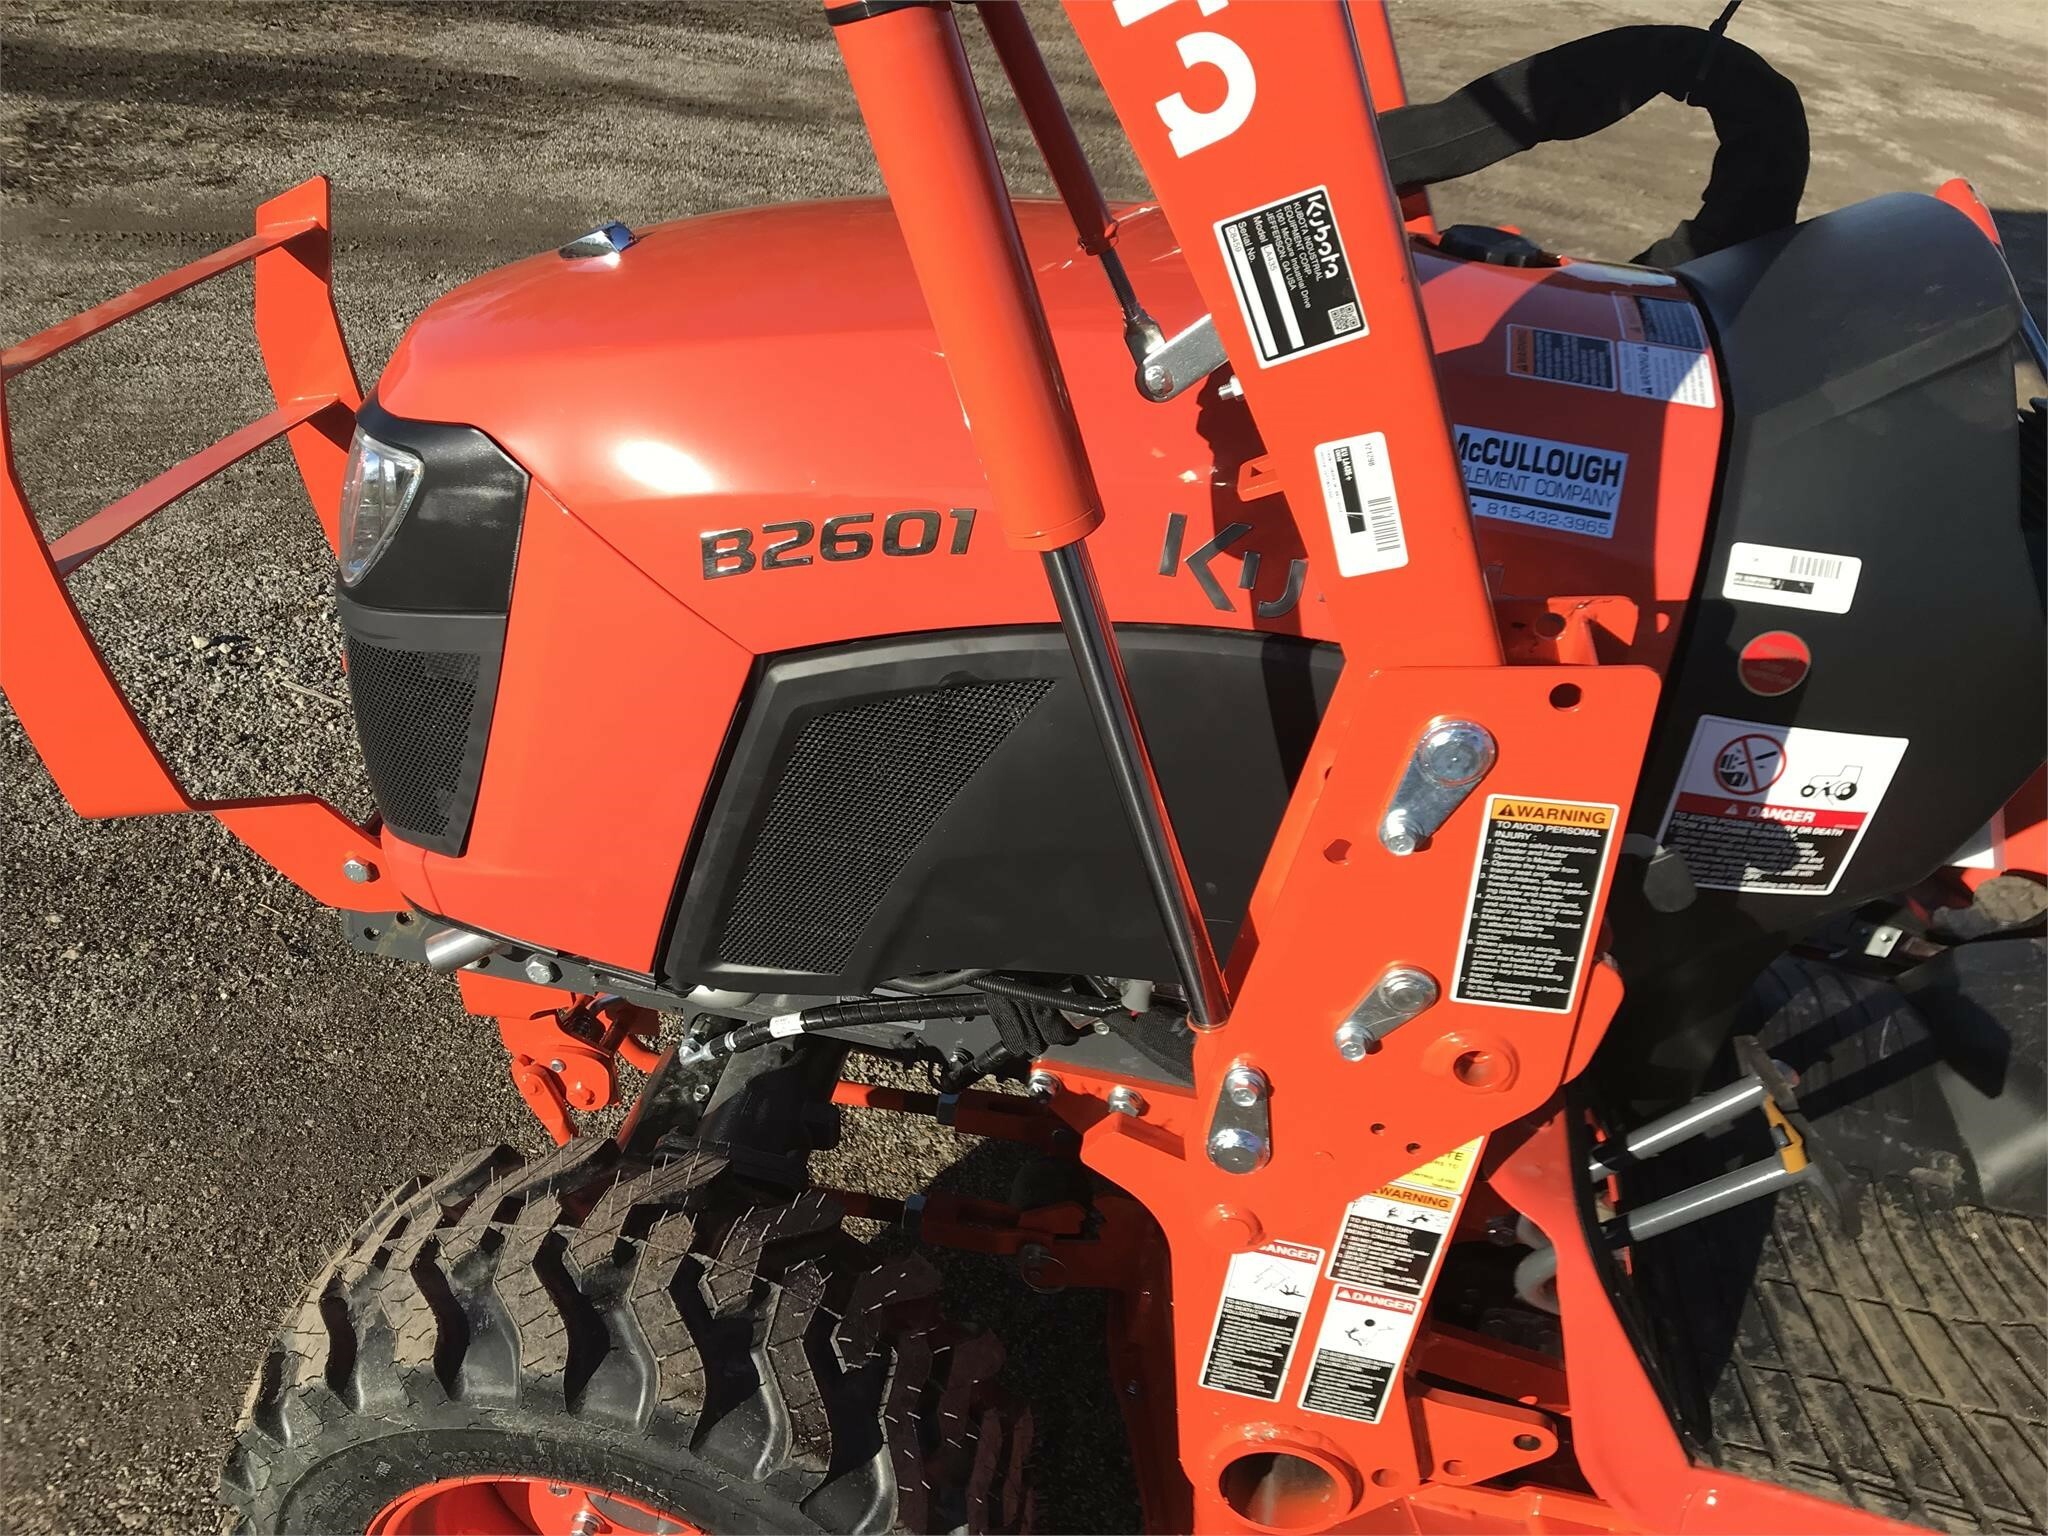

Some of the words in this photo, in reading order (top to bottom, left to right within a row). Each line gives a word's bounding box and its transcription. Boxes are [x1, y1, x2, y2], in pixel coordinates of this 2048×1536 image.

[1237, 221, 1252, 247] Serial
[1246, 247, 1258, 264] No.
[1252, 215, 1268, 244] Model
[1262, 245, 1277, 272] LA435
[1283, 205, 1304, 253] EQUIPMENT
[1298, 252, 1312, 278] CORP.
[1292, 202, 1308, 236] KUBOTA
[1303, 236, 1323, 282] INDUSTRIAL
[1305, 193, 1342, 279] Kubota
[1274, 208, 1286, 227] 1001
[1290, 258, 1306, 290] Industrial
[1300, 290, 1312, 310] Drive
[1280, 261, 1291, 275] GA
[1285, 274, 1297, 292] USA
[1535, 478, 1617, 507] COMPANY
[1487, 502, 1609, 535] 815-432-3965
[701, 508, 977, 580] B2601
[1517, 805, 1606, 824] WARNING
[1746, 805, 1816, 823] DANGER
[1511, 822, 1544, 831] AVOID
[1544, 825, 1602, 836] PERSONAL
[1380, 1187, 1449, 1208] WARNING
[1263, 1244, 1318, 1262] ANGER
[1352, 1293, 1415, 1312] DANGER
